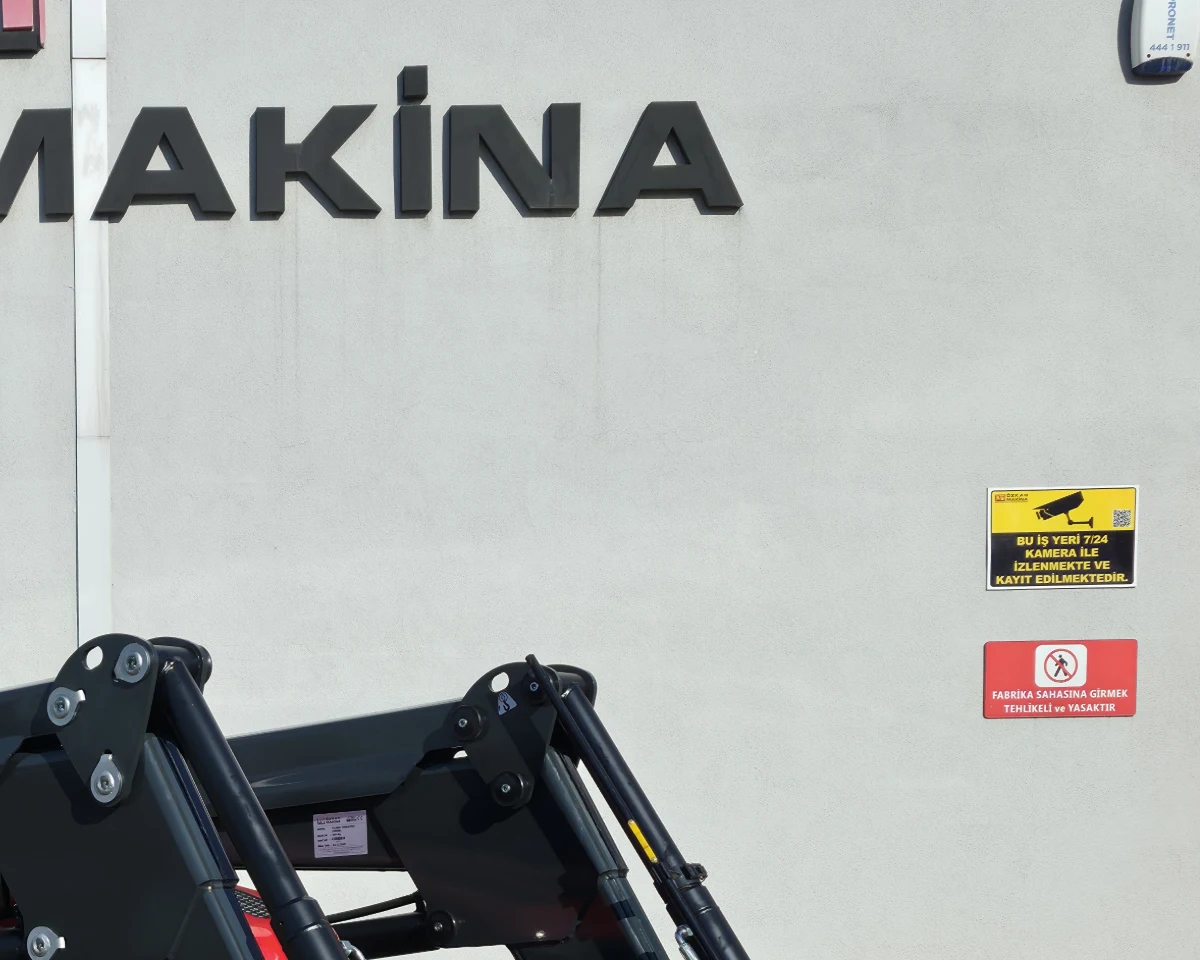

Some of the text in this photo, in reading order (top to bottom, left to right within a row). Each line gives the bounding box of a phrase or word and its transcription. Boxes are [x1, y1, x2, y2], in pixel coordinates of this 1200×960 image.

[1166, 0, 1176, 40] RONET
[1017, 534, 1108, 547] BU İŞ YERİ 7/24
[1025, 546, 1099, 558] KAMERA İLE
[1014, 561, 1110, 571] İZLENMEKTE VE
[996, 572, 1128, 585] KAYIT EDİLMEKTEDİR.
[992, 688, 1128, 699] FABRİKA SAHASINA GİRMEK
[1004, 702, 1052, 713] TEHLİKELİ
[1068, 703, 1115, 712] YASAKTIR
